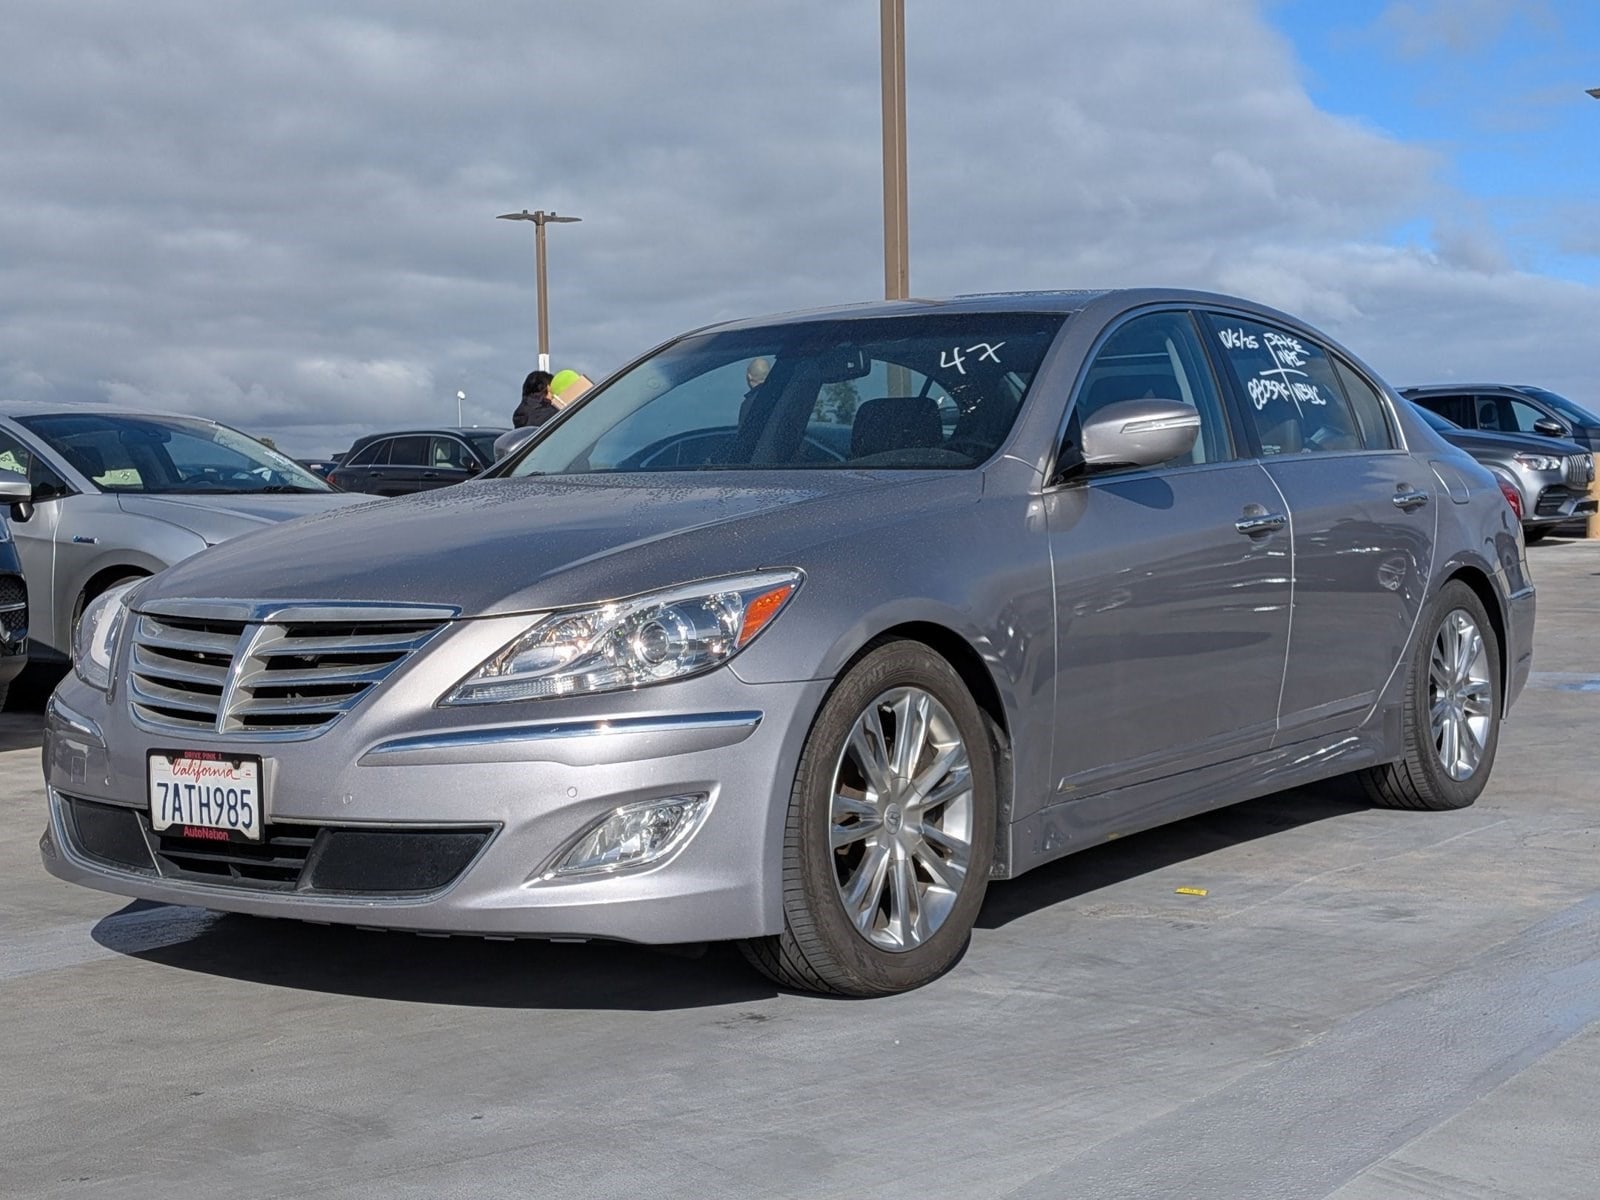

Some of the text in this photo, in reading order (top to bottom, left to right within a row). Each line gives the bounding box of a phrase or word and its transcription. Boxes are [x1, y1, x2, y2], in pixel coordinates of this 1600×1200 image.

[172, 758, 241, 783] California
[157, 782, 253, 829] 7ATH985
[183, 826, 230, 841] AutoNation
